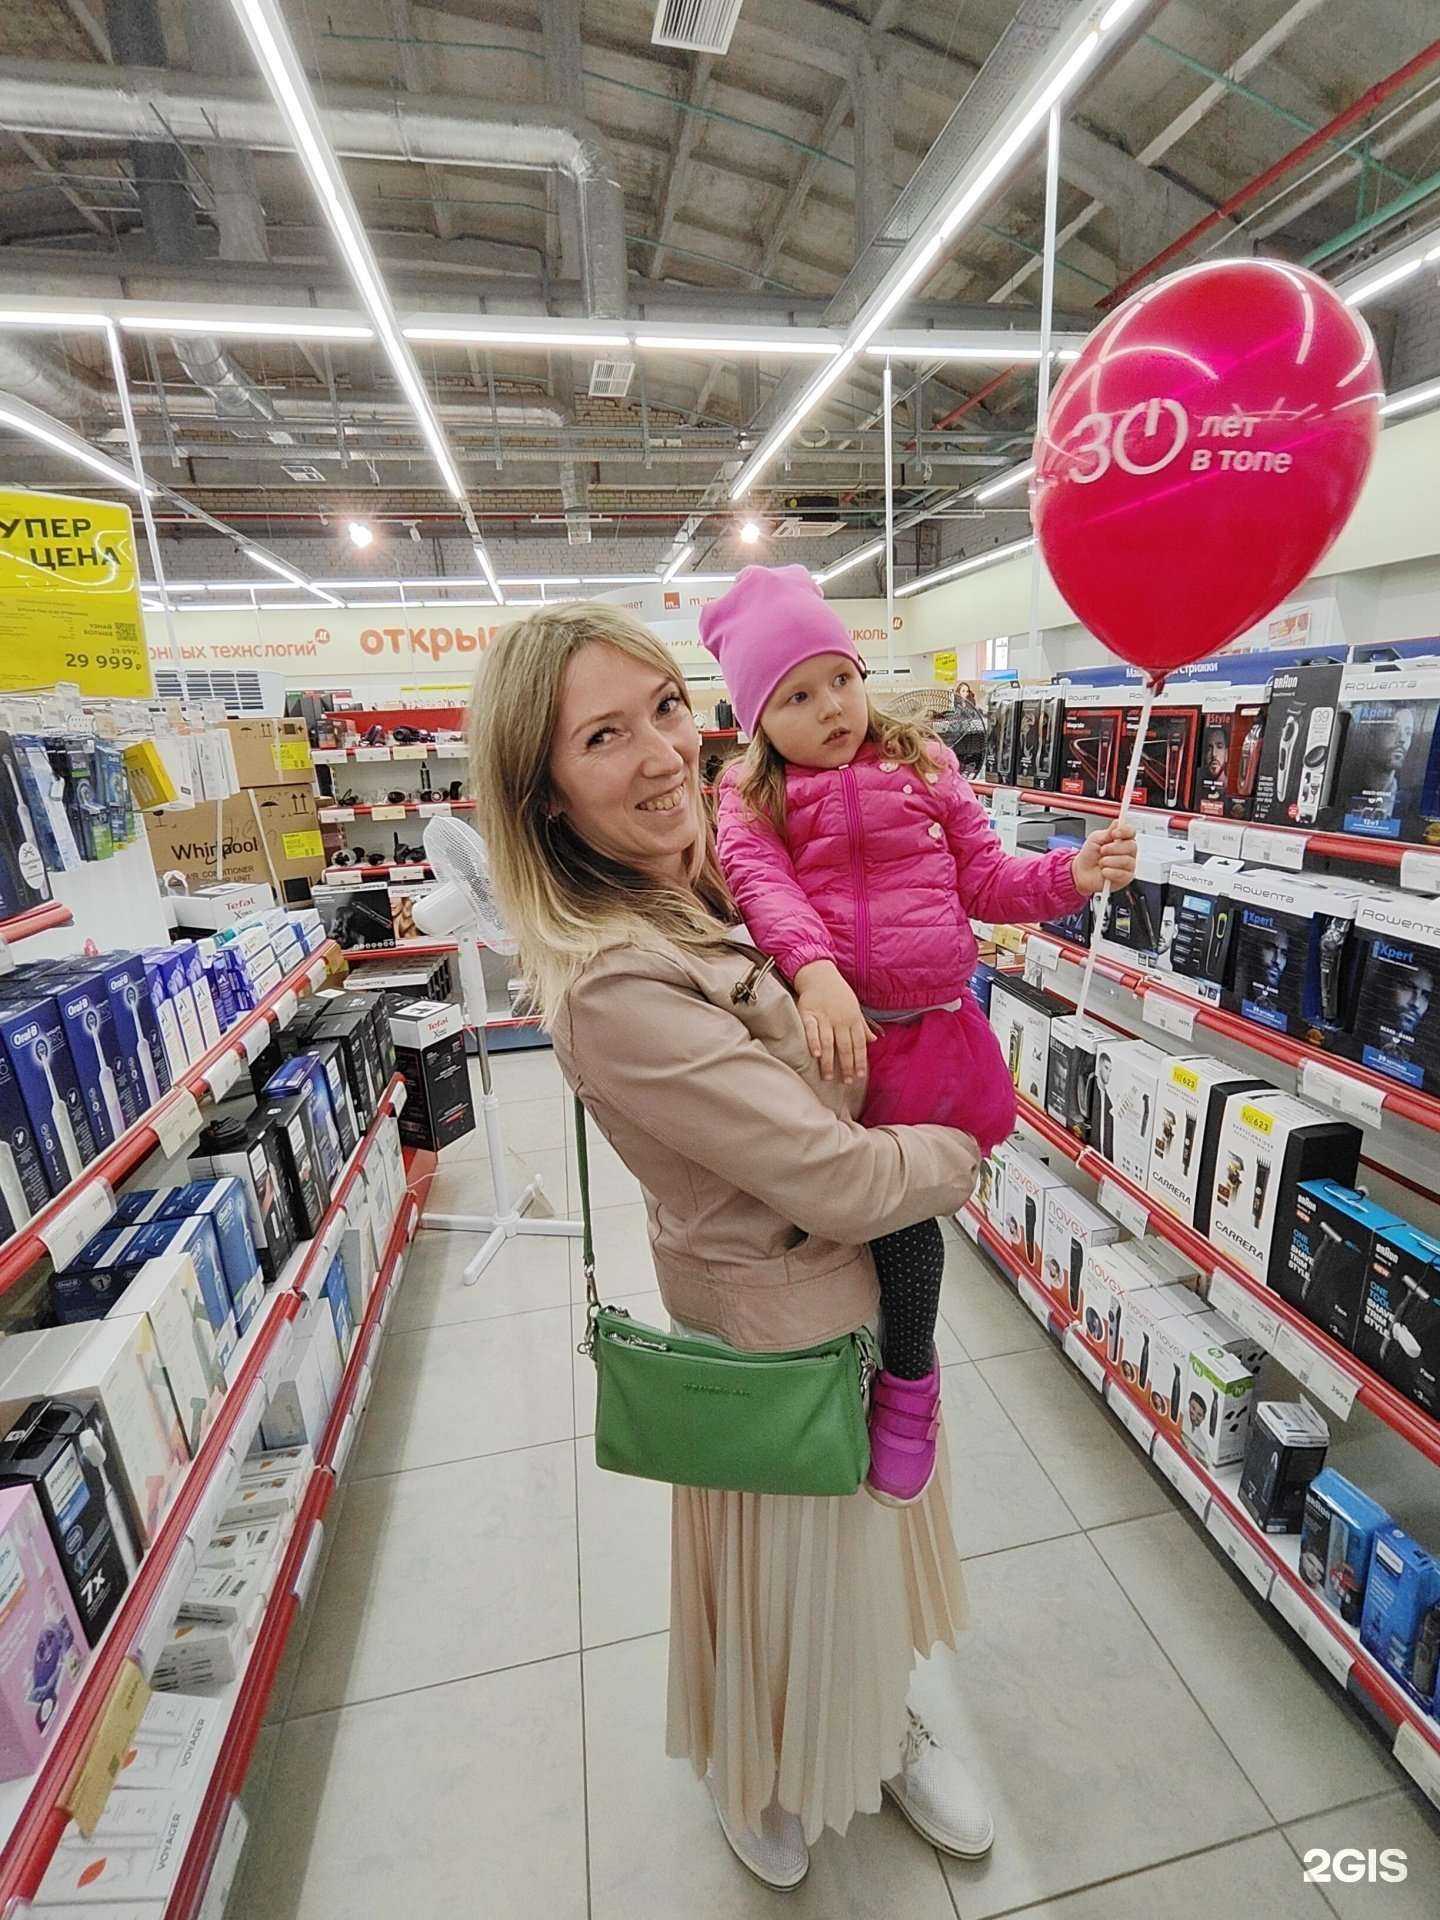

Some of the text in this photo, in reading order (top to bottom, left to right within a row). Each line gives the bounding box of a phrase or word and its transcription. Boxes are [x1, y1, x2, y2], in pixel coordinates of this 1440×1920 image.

[1070, 398, 1261, 484] 30 лет
[1190, 449, 1293, 473] в топе
[0, 518, 91, 538] УПЕР
[30, 547, 122, 571] ЦЕНА
[64, 653, 89, 668] 29
[171, 837, 259, 865] Whirpool
[225, 897, 255, 911] Tefal
[68, 998, 89, 1017] Oral-B
[14, 1024, 38, 1046] Oral-B
[1152, 1171, 1192, 1206] CARRERA
[1049, 1200, 1088, 1243] novex
[1215, 1220, 1265, 1261] CARRERA
[1290, 1251, 1308, 1270] TRIM
[1291, 1244, 1315, 1267] SHAVE
[1087, 1257, 1126, 1301] novex
[1369, 1280, 1389, 1298] ONE
[1367, 1297, 1396, 1324] SHAVE
[1369, 1288, 1392, 1311] TOOL
[1366, 1305, 1387, 1328] TRIM
[180, 1717, 205, 1768] VOYAGER
[156, 1813, 181, 1871] VOYAGER
